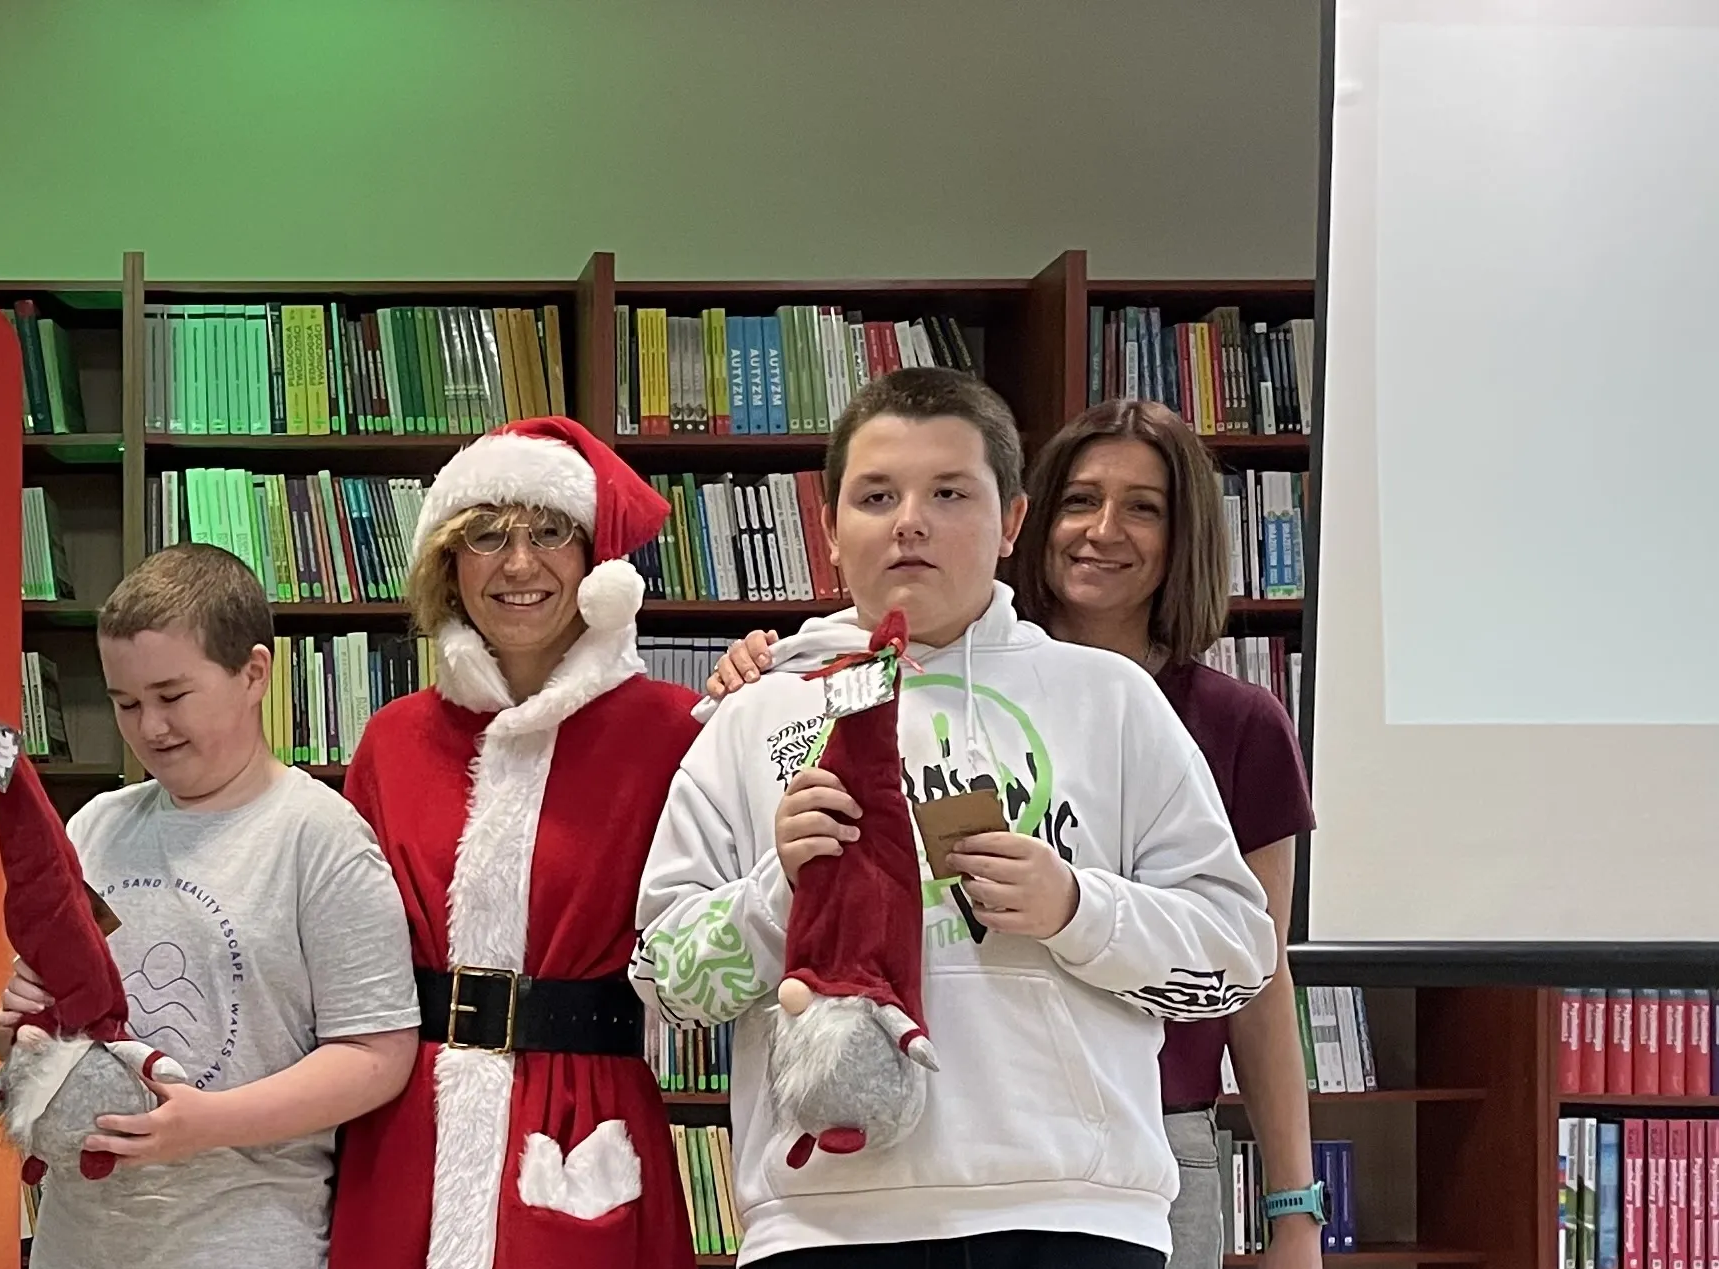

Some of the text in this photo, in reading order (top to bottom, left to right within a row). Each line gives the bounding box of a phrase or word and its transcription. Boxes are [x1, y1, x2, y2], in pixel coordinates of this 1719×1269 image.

[731, 349, 744, 406] AUTYZM
[750, 349, 763, 406] AUTYZM
[769, 349, 783, 406] AUTYZM
[174, 878, 222, 915] REALITY
[221, 1003, 240, 1058] WAVES
[195, 1061, 222, 1090] AND
